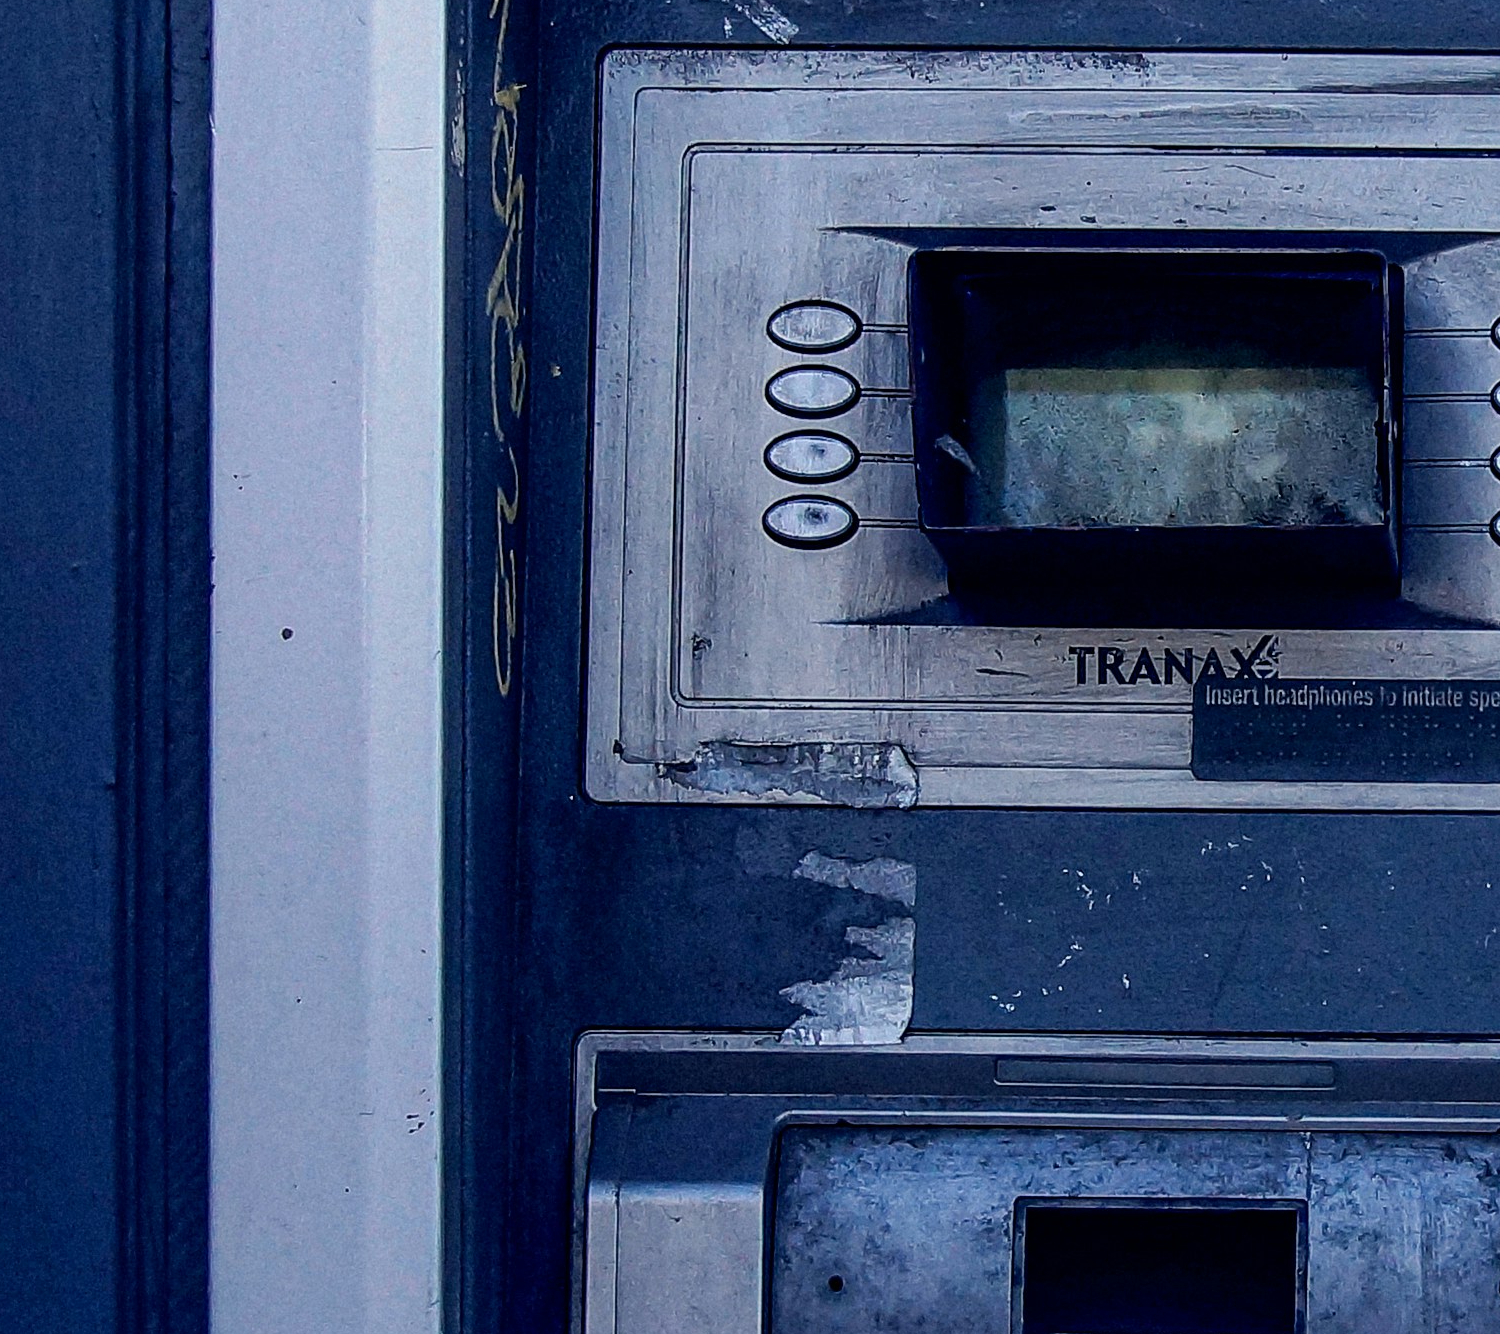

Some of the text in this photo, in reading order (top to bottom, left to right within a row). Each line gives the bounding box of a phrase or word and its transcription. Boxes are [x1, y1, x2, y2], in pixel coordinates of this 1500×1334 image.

[1069, 636, 1279, 685] TRANAX
[1206, 685, 1259, 707] Insert
[1265, 685, 1374, 710] headphones
